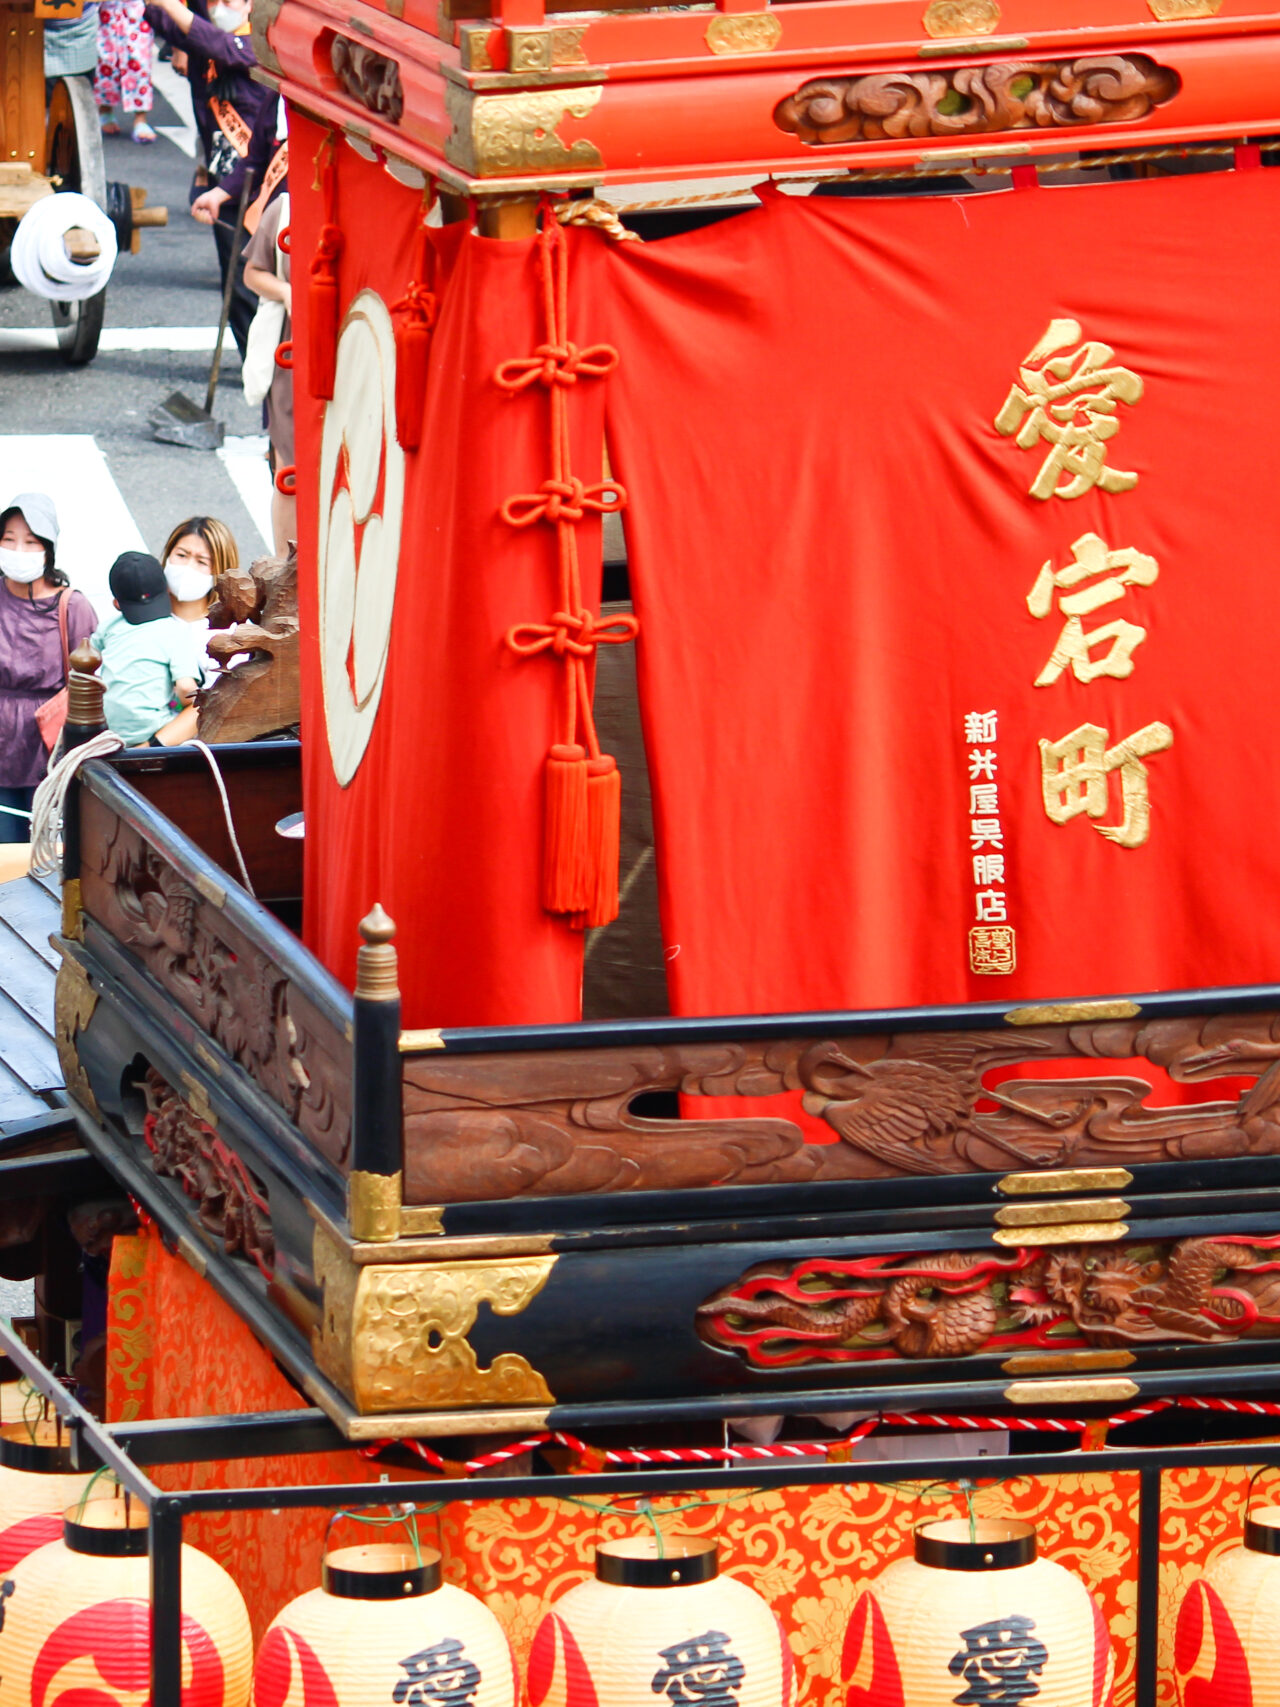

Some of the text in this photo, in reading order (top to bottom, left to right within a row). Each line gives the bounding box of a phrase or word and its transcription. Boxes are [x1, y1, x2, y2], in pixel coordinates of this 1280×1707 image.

[995, 318, 1174, 850] 愛宕町
[964, 709, 1008, 922] 新井屋呉服店
[651, 1630, 746, 1707] 愛
[947, 1614, 1049, 1707] 愛
